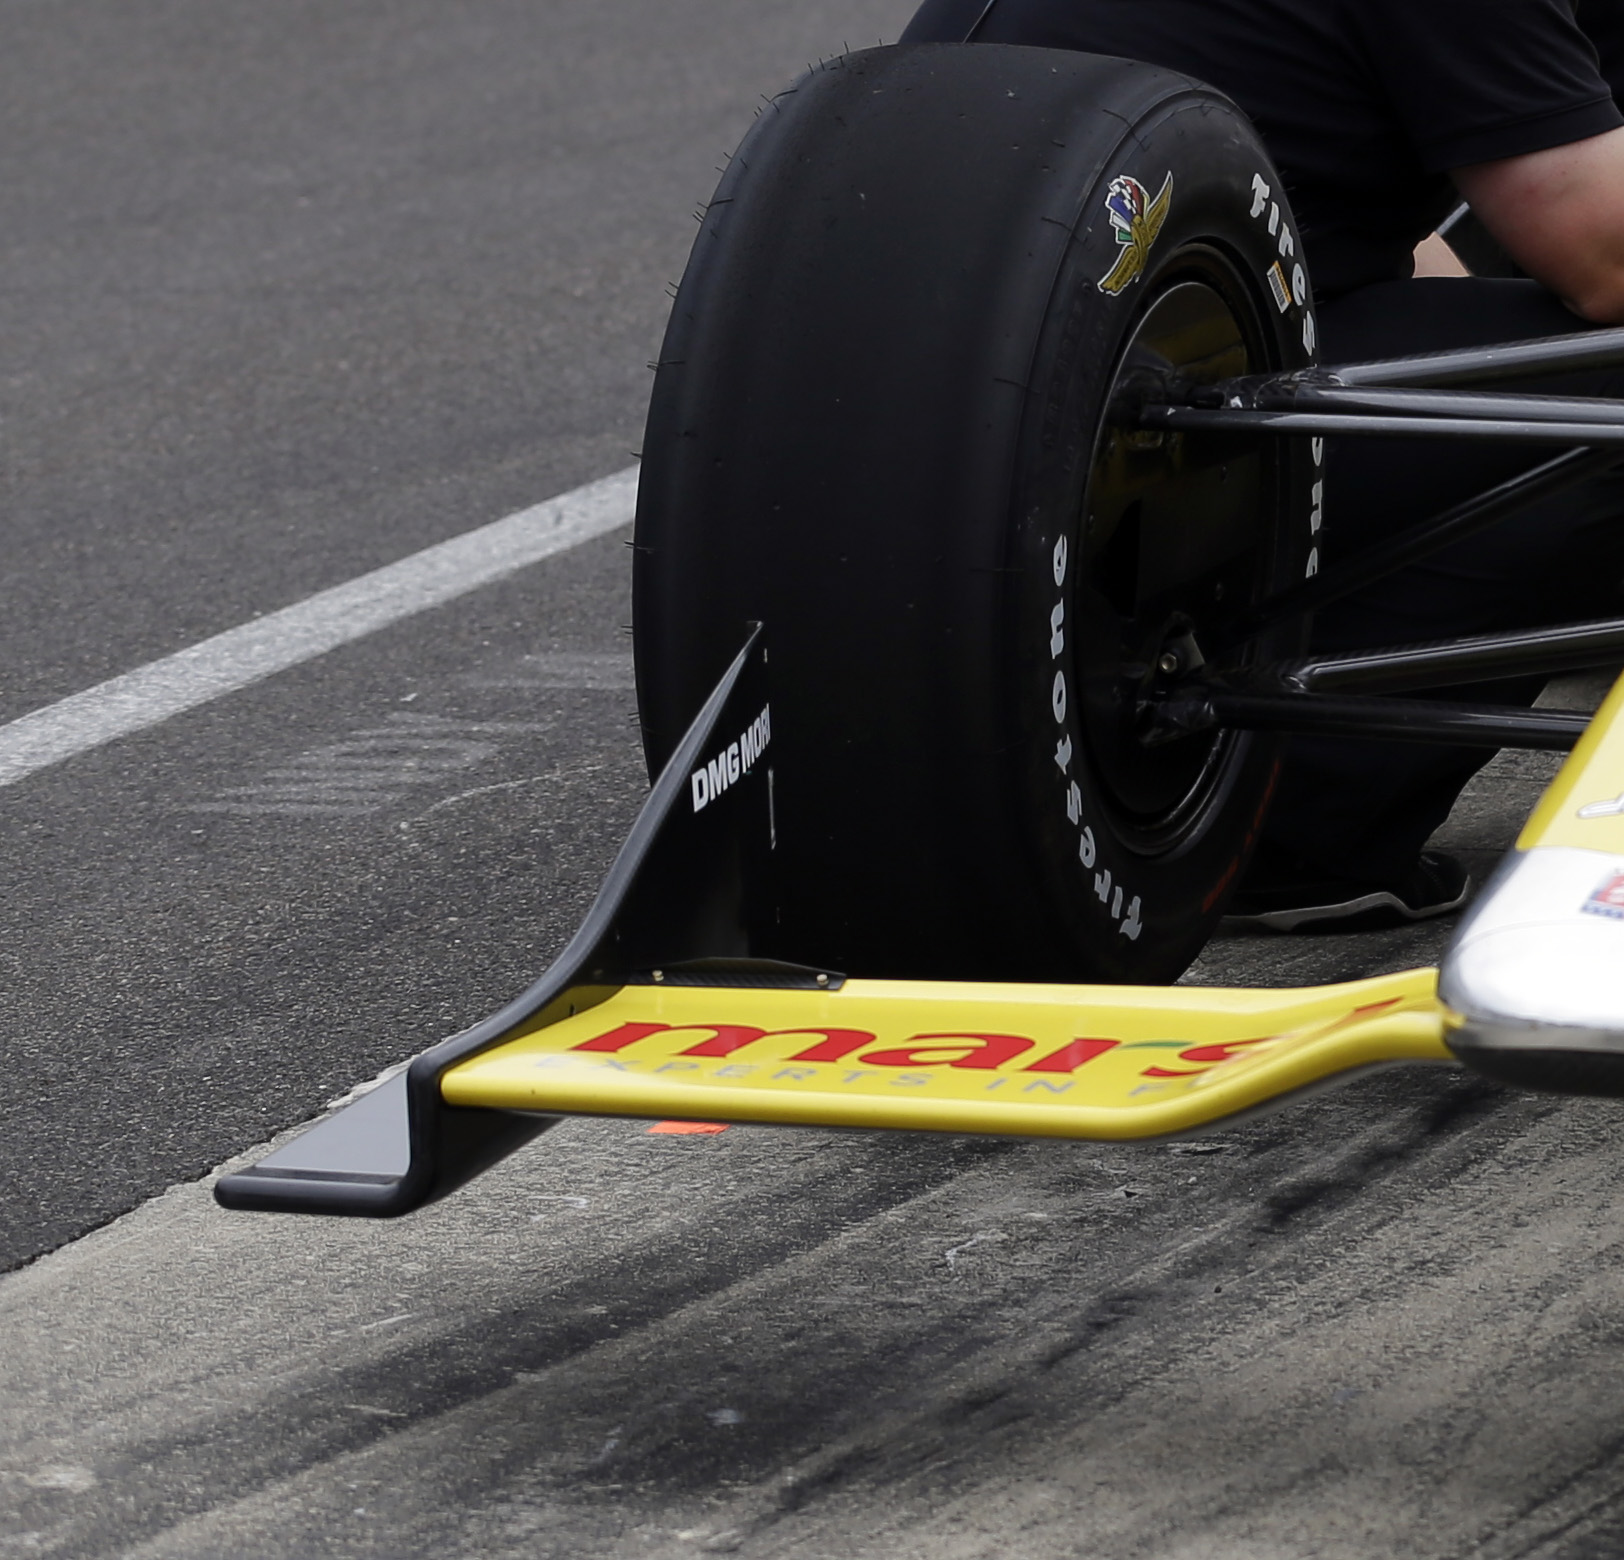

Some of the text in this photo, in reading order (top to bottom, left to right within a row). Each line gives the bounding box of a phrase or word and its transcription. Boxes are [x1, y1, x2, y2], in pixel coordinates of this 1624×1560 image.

[692, 702, 771, 812] DMG MORI
[1050, 534, 1142, 940] Firestone
[534, 1056, 1078, 1095] EXPERTS IN
[569, 1018, 1265, 1078] mars
